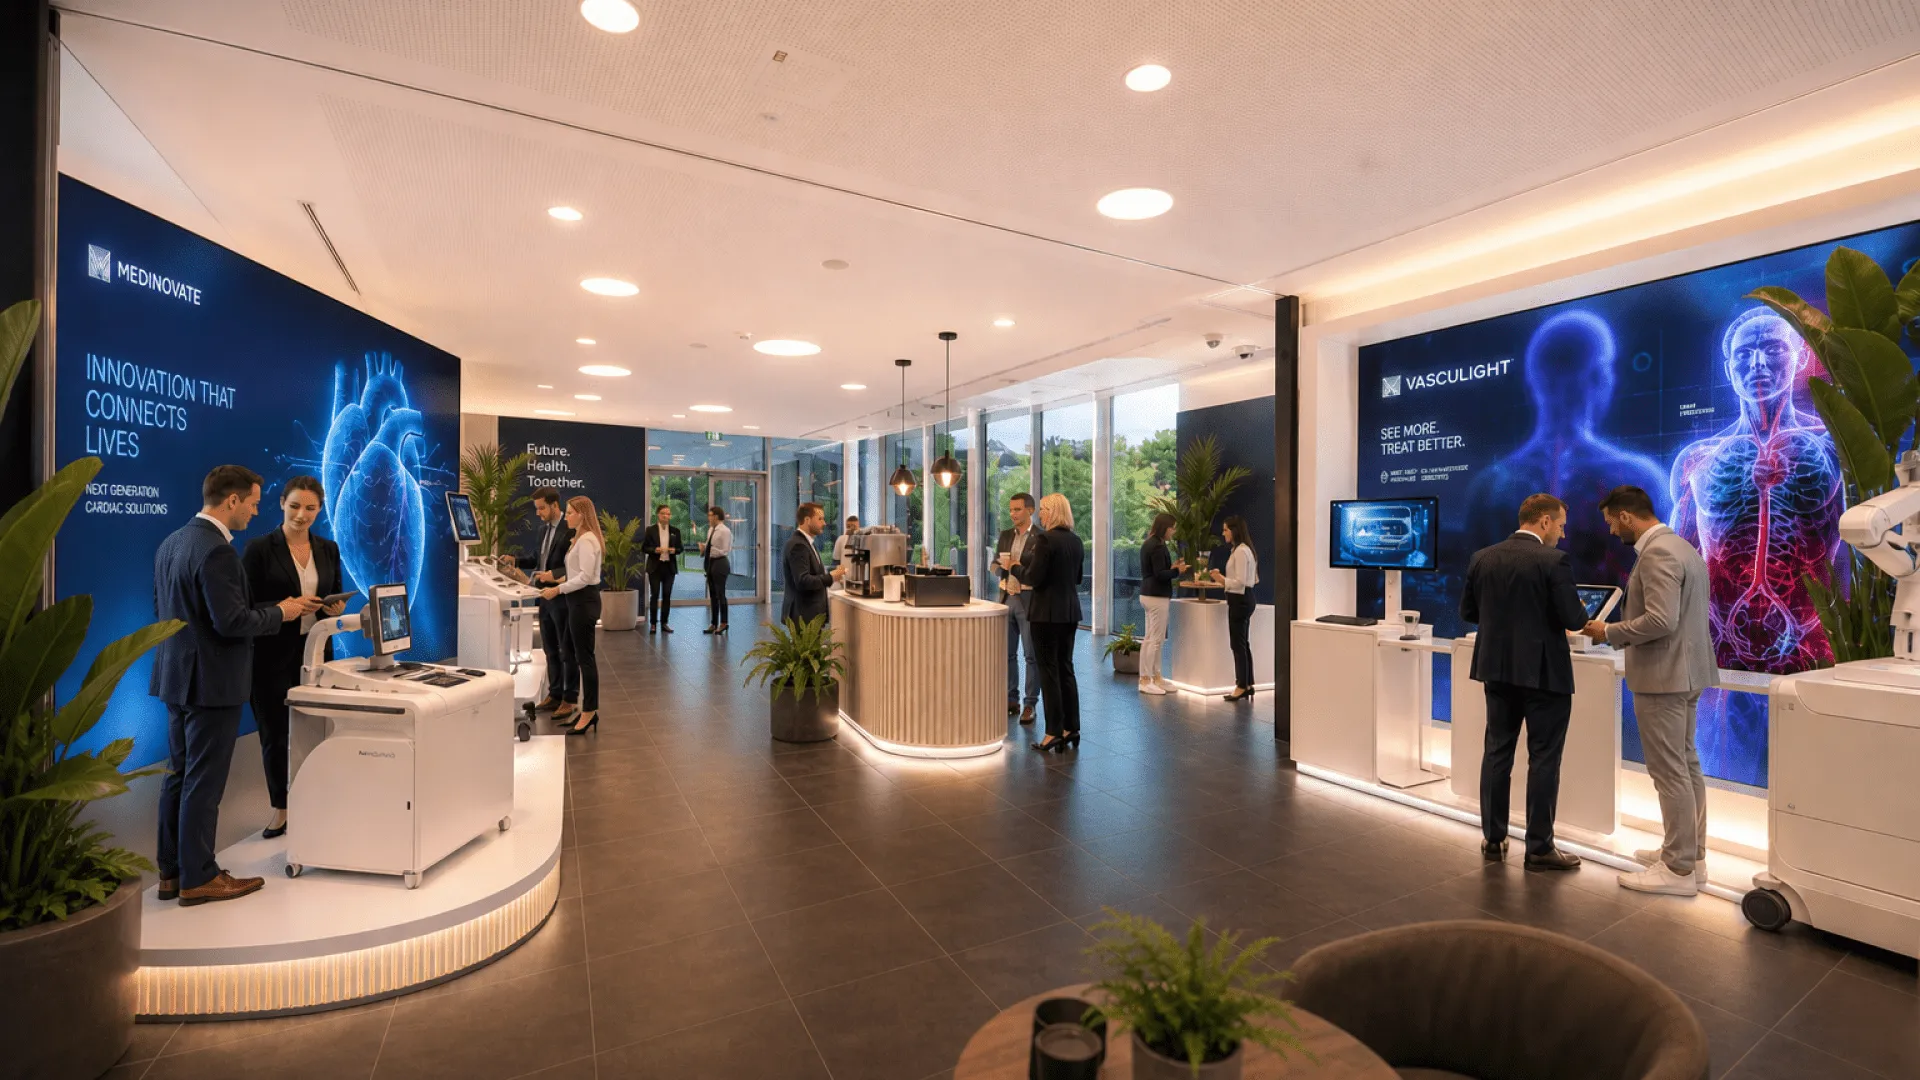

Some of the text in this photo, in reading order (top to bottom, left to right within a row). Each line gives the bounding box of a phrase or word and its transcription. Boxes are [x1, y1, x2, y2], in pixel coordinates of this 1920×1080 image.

[117, 261, 202, 306] MEDINOVATE
[86, 353, 236, 409] INNOVATION THAT
[1406, 359, 1511, 391] VASCULIGHT
[86, 390, 187, 431] CONNECTS
[1381, 421, 1440, 440] SEE MORE.
[86, 425, 140, 458] LIVES
[527, 443, 571, 457] Future.
[1381, 435, 1465, 455] TREAT BETTER.
[527, 459, 571, 473] Health.
[85, 483, 159, 498] NEXT GENERATION
[85, 500, 168, 515] CARDIAC SOLUTIONS
